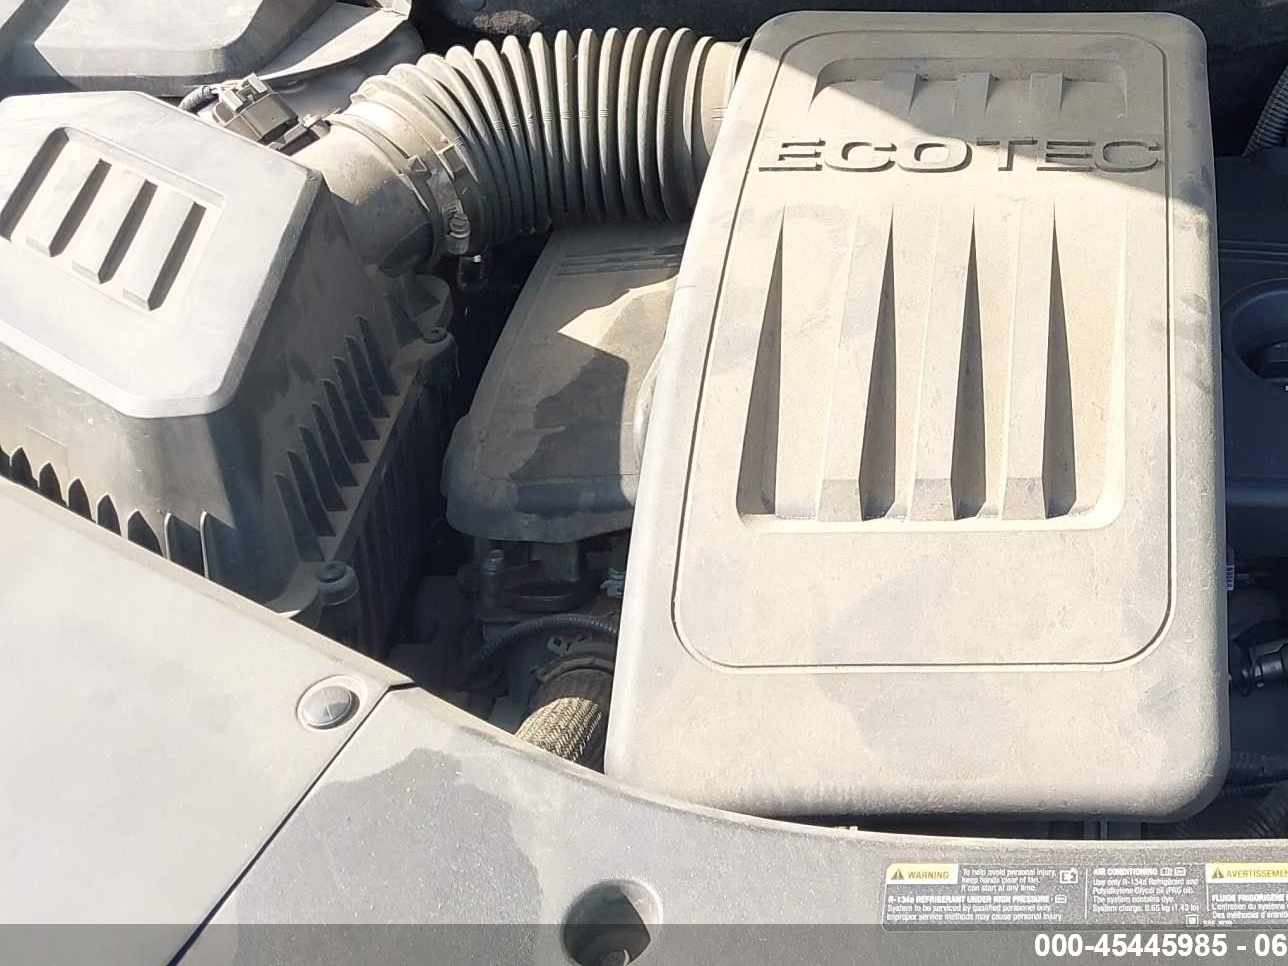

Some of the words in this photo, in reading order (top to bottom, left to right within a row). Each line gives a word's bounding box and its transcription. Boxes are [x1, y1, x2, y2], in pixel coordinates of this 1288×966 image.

[759, 137, 1162, 173] ECOTEC
[908, 871, 949, 880] WARNING
[963, 868, 970, 877] To
[972, 868, 986, 877] help
[988, 868, 1005, 877] avoid
[1007, 868, 1036, 877] personal
[1094, 868, 1106, 876] AIR
[1107, 868, 1158, 876] CONDITIONING
[1212, 894, 1236, 902] FLUIDE
